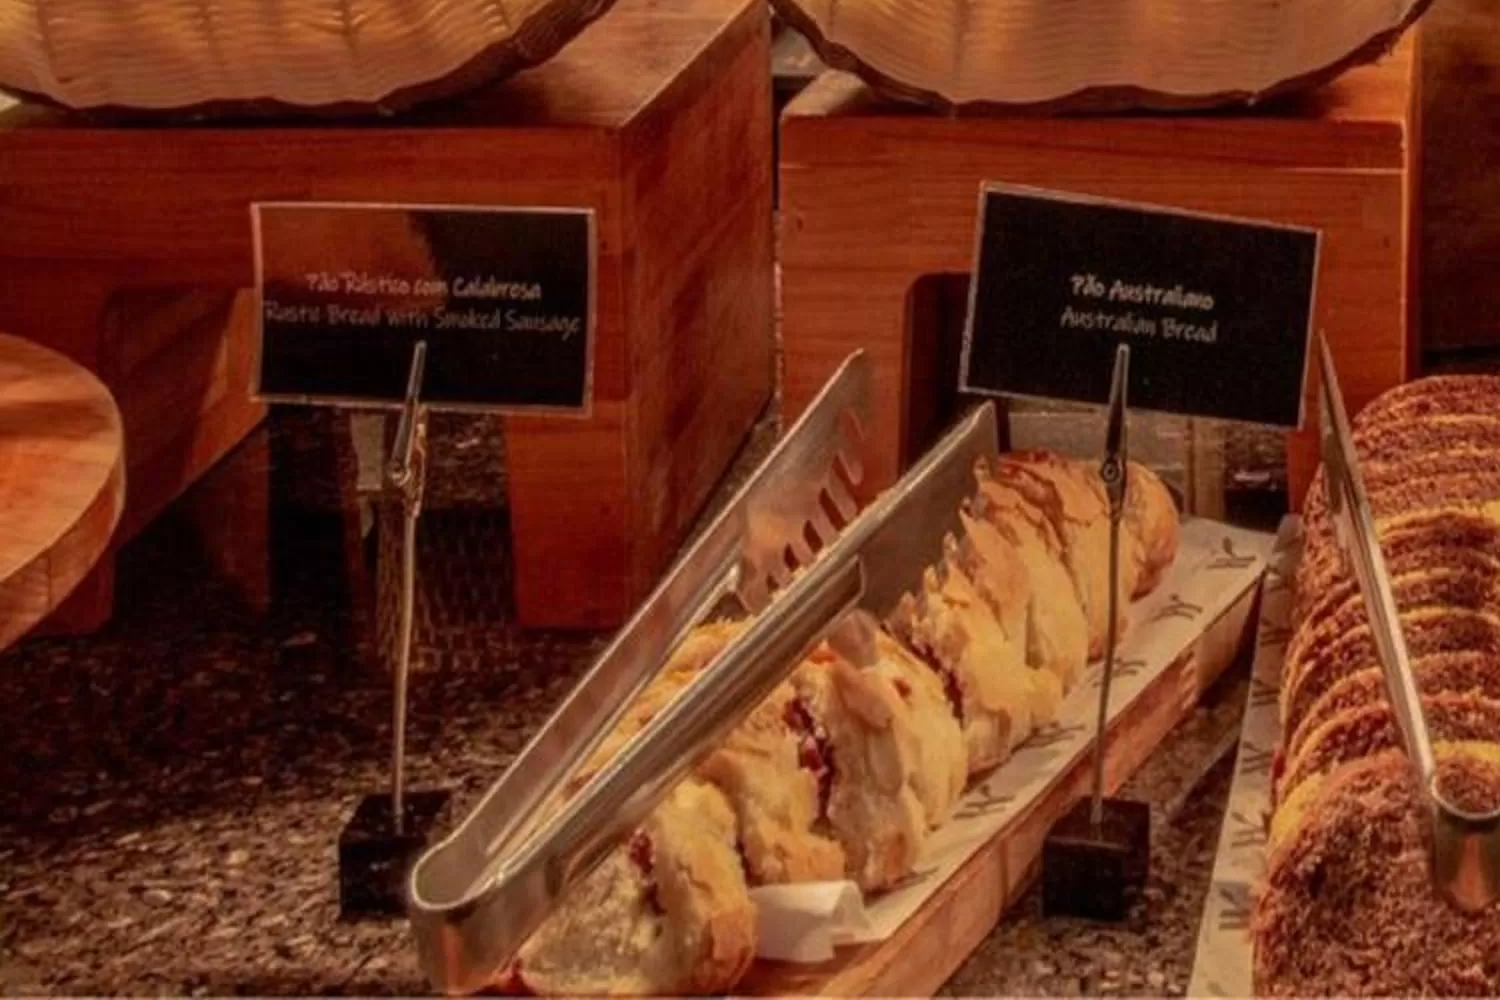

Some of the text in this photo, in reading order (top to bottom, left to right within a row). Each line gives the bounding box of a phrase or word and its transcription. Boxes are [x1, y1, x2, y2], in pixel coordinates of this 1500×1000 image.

[433, 304, 502, 329] Smoked
[1059, 304, 1219, 344] Australian Bread
